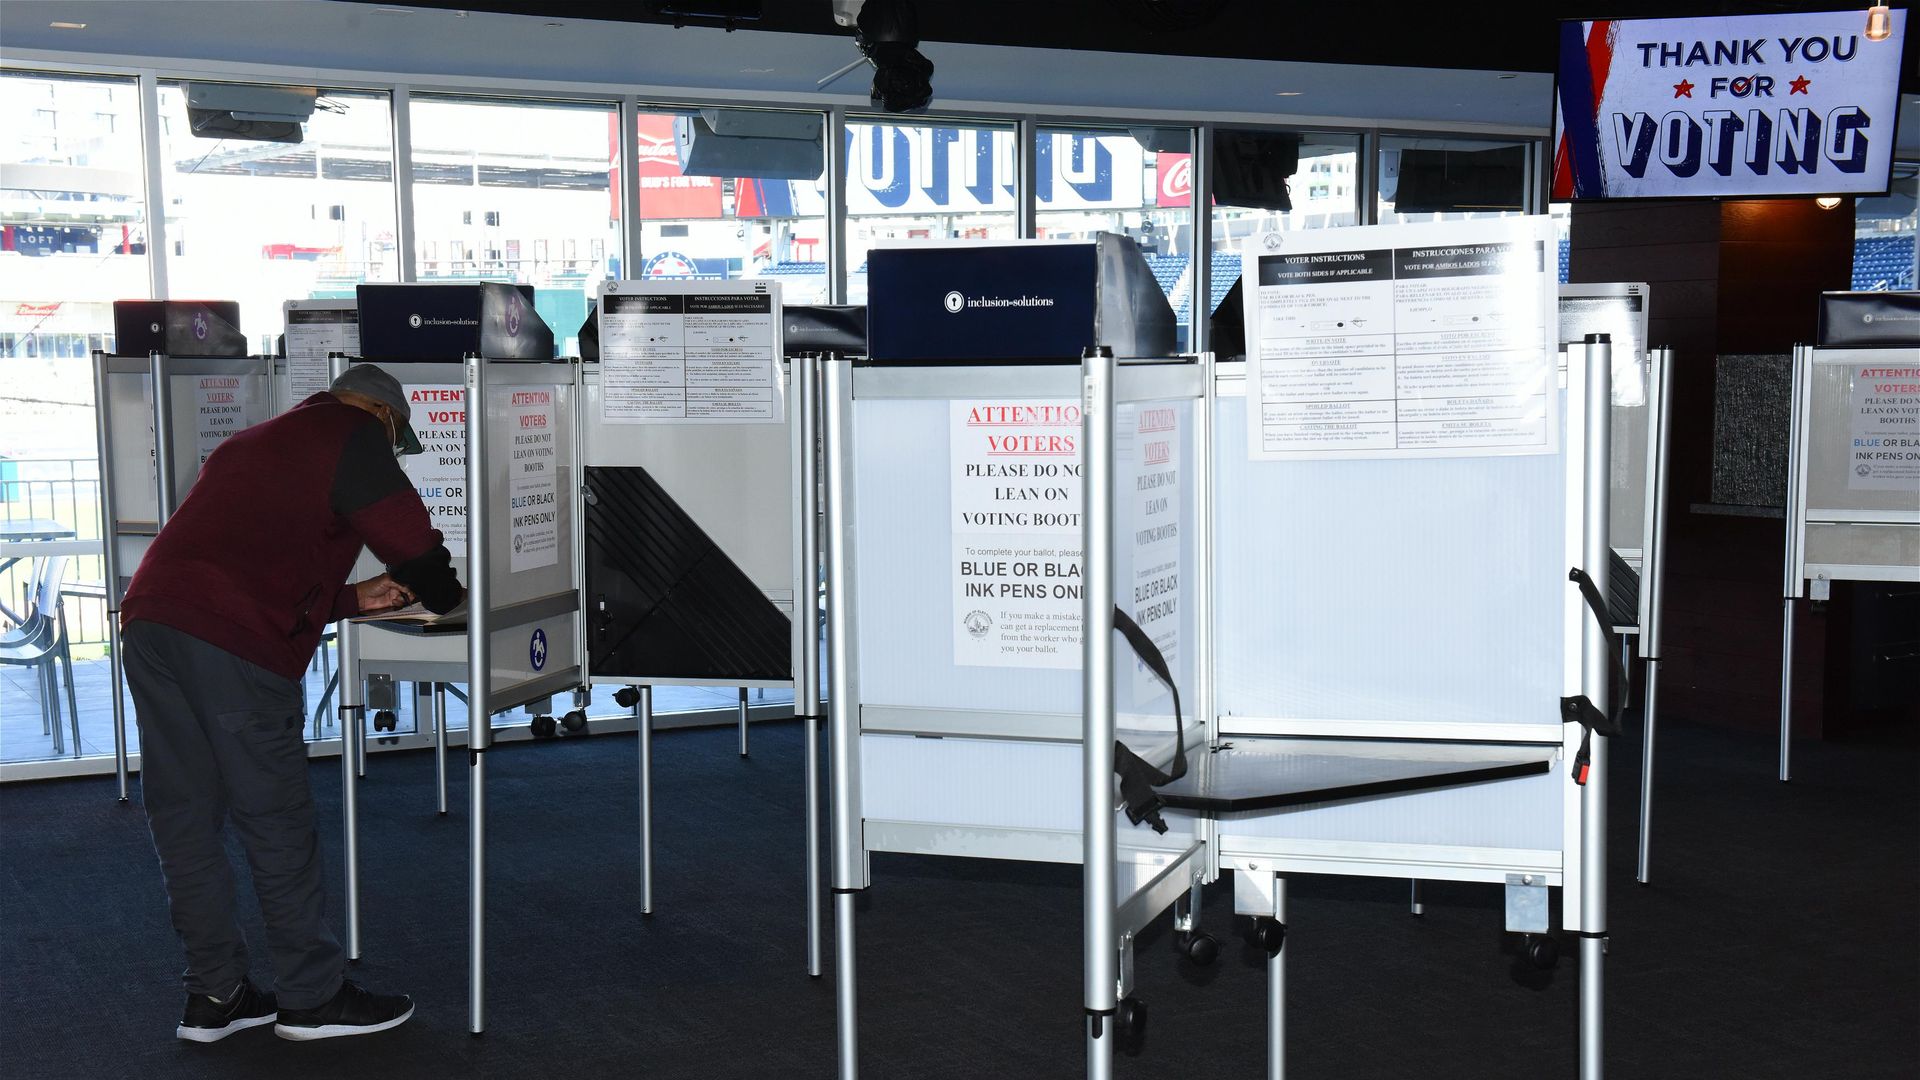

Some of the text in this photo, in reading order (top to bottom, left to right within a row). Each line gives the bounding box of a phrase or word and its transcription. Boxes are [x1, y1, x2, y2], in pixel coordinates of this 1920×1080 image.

[1637, 35, 1858, 68] THANK YOU
[1710, 75, 1775, 98] FOR
[1612, 106, 1871, 178] VOTING
[671, 176, 690, 188] FOR
[20, 235, 54, 244] LOFT
[1412, 247, 1475, 258] INSTRUCCIONES
[1476, 245, 1495, 255] PARA
[1285, 253, 1366, 265] VOTER INSTRUCTIONS
[1435, 262, 1458, 270] AMBOS
[1459, 260, 1480, 269] LADOS
[1337, 268, 1374, 276] APPLICABLE
[200, 377, 240, 389] ATTENTION
[206, 392, 234, 404] VOTERS
[511, 391, 550, 405] ATTENTION
[200, 406, 221, 414] PLEASE
[210, 418, 224, 426] LEAN
[519, 414, 547, 427] VOTERS
[1138, 408, 1176, 428] ATTENTION
[200, 431, 222, 439] VOTING
[419, 430, 458, 439] PLEASE
[515, 433, 551, 445] PLEASE DO NOT
[445, 443, 460, 453] ON
[988, 435, 1075, 452] VOTERS
[1854, 438, 1880, 447] BLUE
[1882, 439, 1898, 447] OR
[513, 447, 554, 459] LEAN ON VOTING
[1144, 441, 1170, 460] VOTERS
[1855, 452, 1873, 460] INK
[1876, 452, 1903, 460] PENS
[524, 461, 545, 472] BOOTHS
[966, 464, 1029, 477] PLEASE
[1034, 464, 1058, 477] DO
[1137, 470, 1176, 491] PLEASE DO NOT
[445, 487, 463, 498] OR
[995, 487, 1069, 501] LEAN ON
[511, 493, 555, 508] BLUE OR BLACK
[1145, 497, 1168, 515] LEAN ON
[513, 511, 556, 528] INK PENS ONLY
[962, 512, 1028, 526] VOTING
[1136, 523, 1177, 545] VOTING BOOTHS
[965, 548, 976, 556] To
[977, 548, 1013, 559] complete
[1014, 549, 1032, 558] your
[1033, 548, 1057, 557] ballot,
[961, 561, 1083, 577] BLUE OR BLA
[965, 583, 995, 597] INK
[1000, 583, 1047, 599] PENS
[1135, 574, 1178, 604] BLUE OR BLACK
[1000, 611, 1007, 619] If
[1008, 613, 1023, 621] you
[1024, 612, 1045, 620] make
[1146, 603, 1161, 622] PENS
[1162, 598, 1177, 617] ONLY
[1015, 624, 1026, 633] get
[1034, 624, 1080, 633] replacement
[1000, 633, 1078, 643] from the worker who
[1000, 644, 1059, 654] you your ballot.
